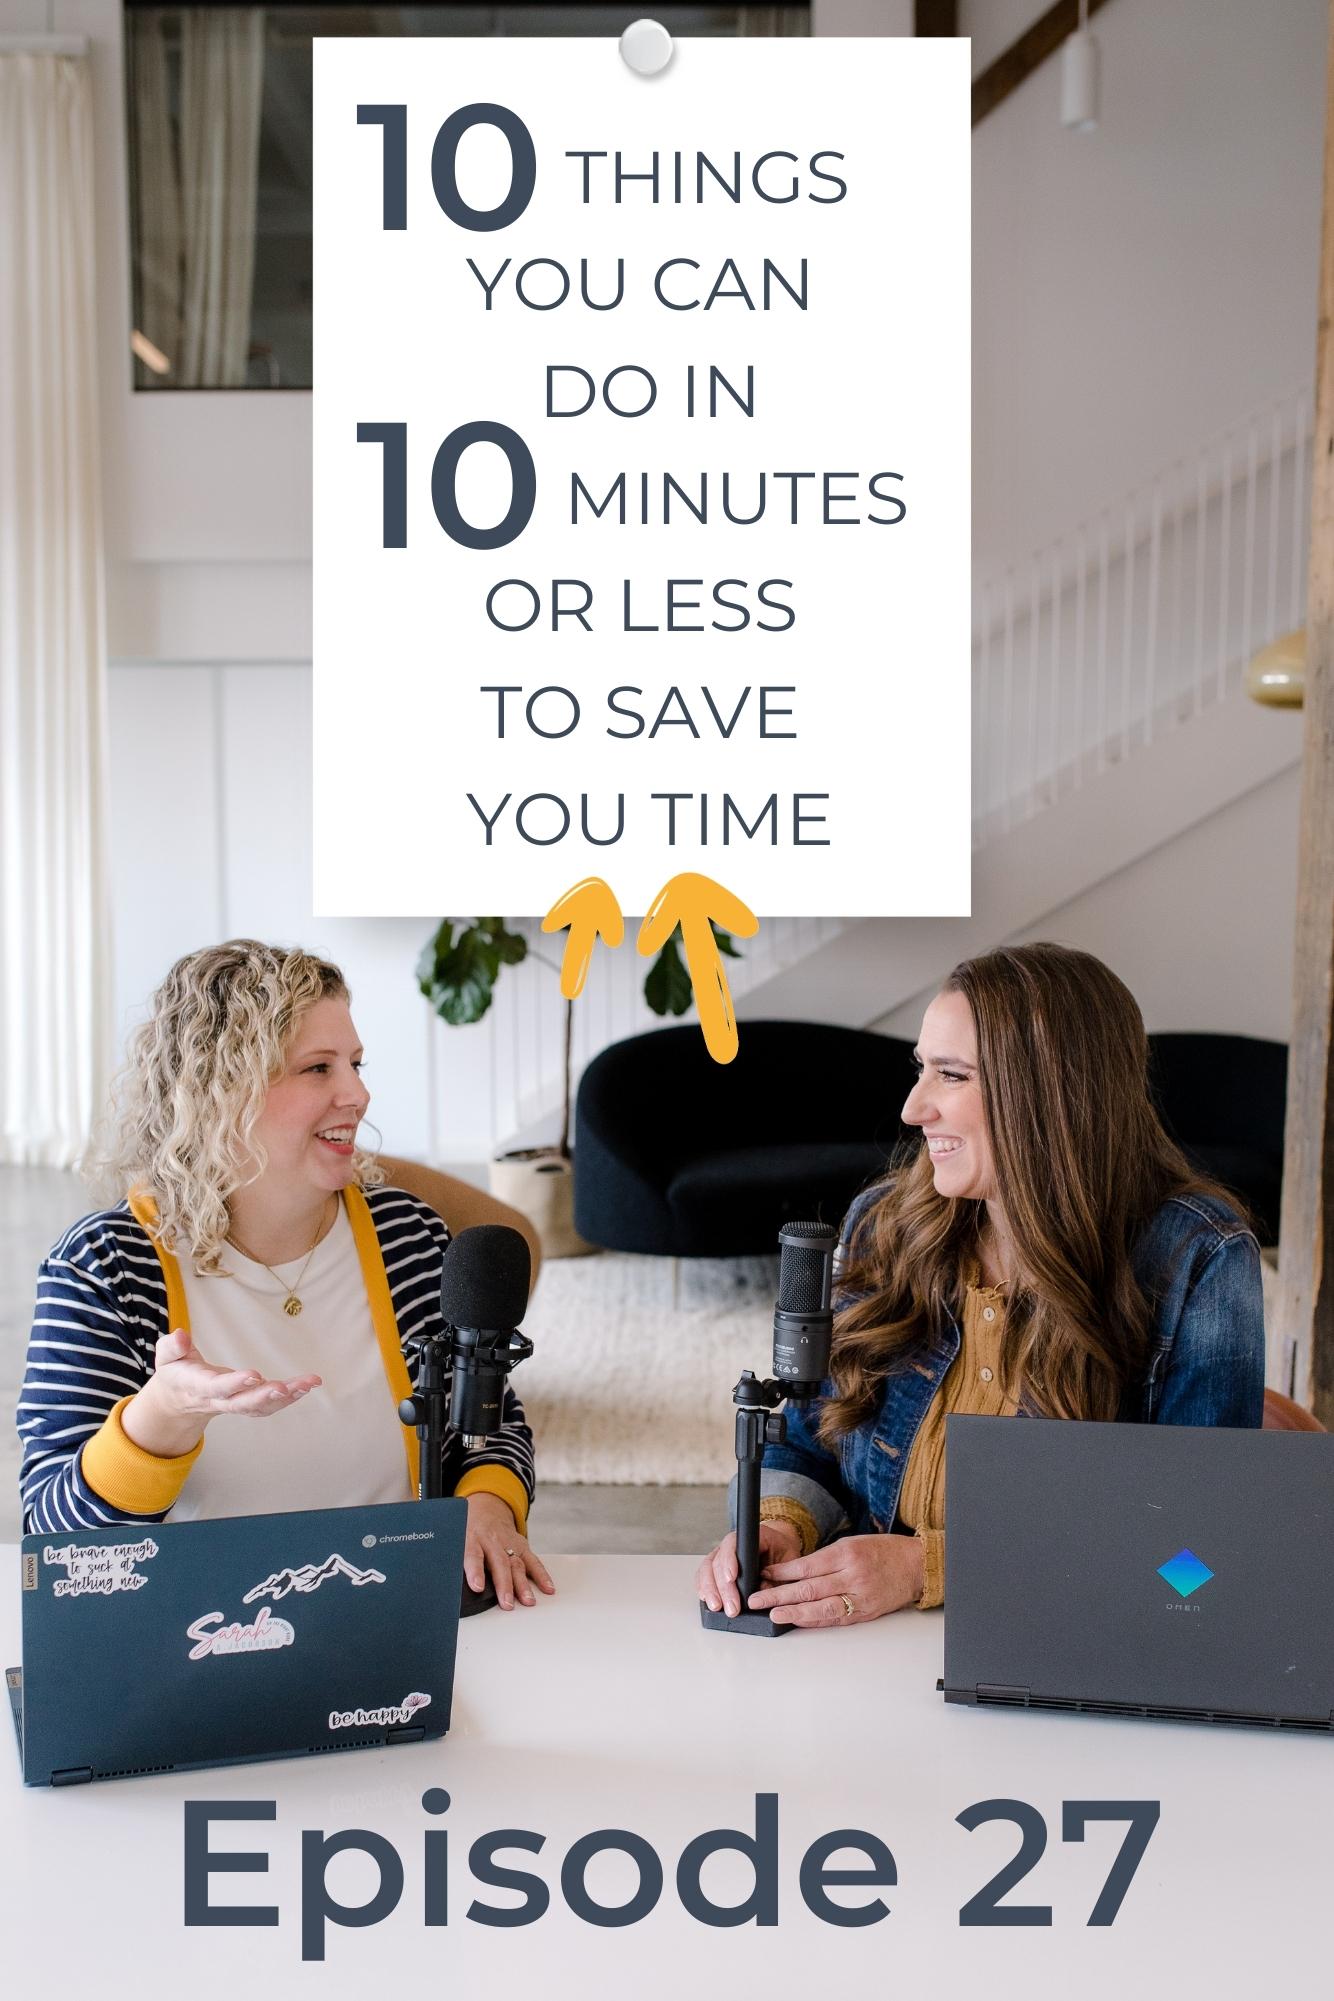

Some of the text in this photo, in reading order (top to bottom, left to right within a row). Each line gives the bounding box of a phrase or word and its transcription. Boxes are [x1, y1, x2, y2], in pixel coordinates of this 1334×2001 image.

[379, 1531, 434, 1543] chromebook
[47, 1541, 156, 1561] be brave enough
[25, 1556, 35, 1588] Lenovo
[71, 1557, 132, 1575] to suck at
[57, 1575, 143, 1594] something new
[191, 1609, 272, 1656] Sarah
[332, 1708, 411, 1726] be happy
